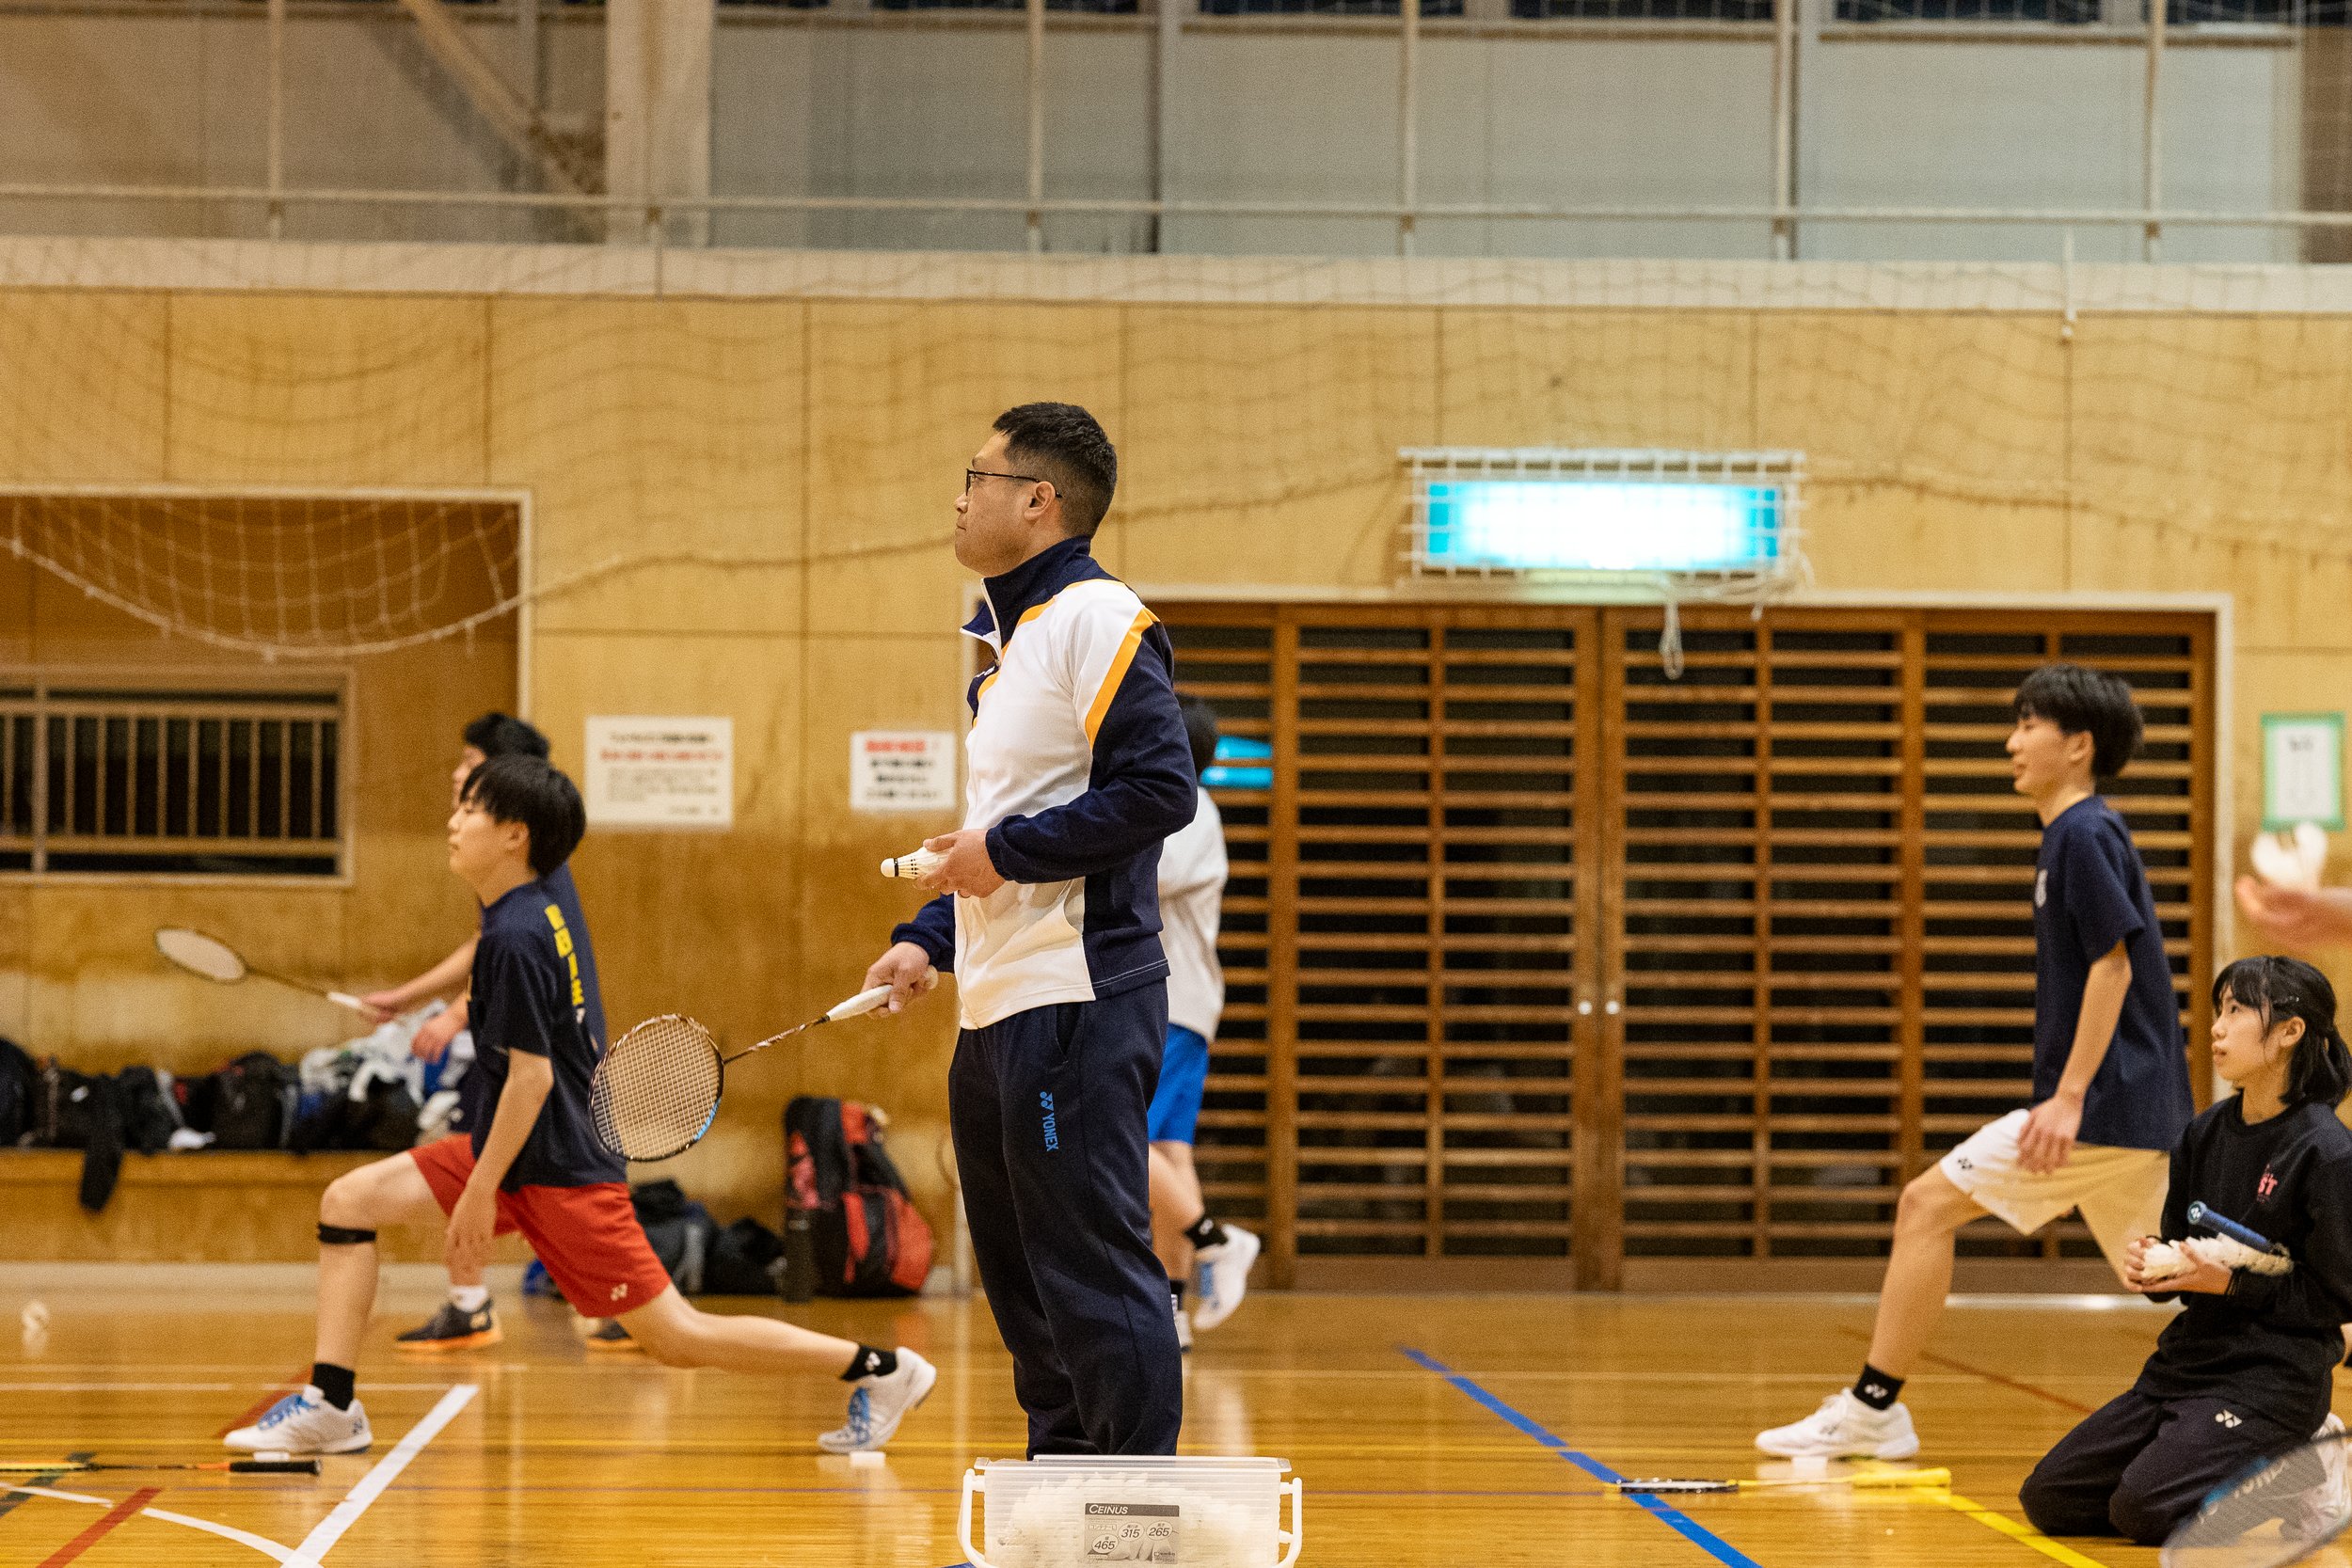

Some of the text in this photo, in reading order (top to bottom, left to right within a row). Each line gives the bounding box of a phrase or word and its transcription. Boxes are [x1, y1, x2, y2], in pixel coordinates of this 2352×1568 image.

[1042, 1112, 1058, 1151] YONEX
[1089, 1504, 1129, 1514] CEINUS
[1120, 1528, 1141, 1539] 315
[1148, 1527, 1170, 1537] 265
[1094, 1541, 1116, 1550] 465
